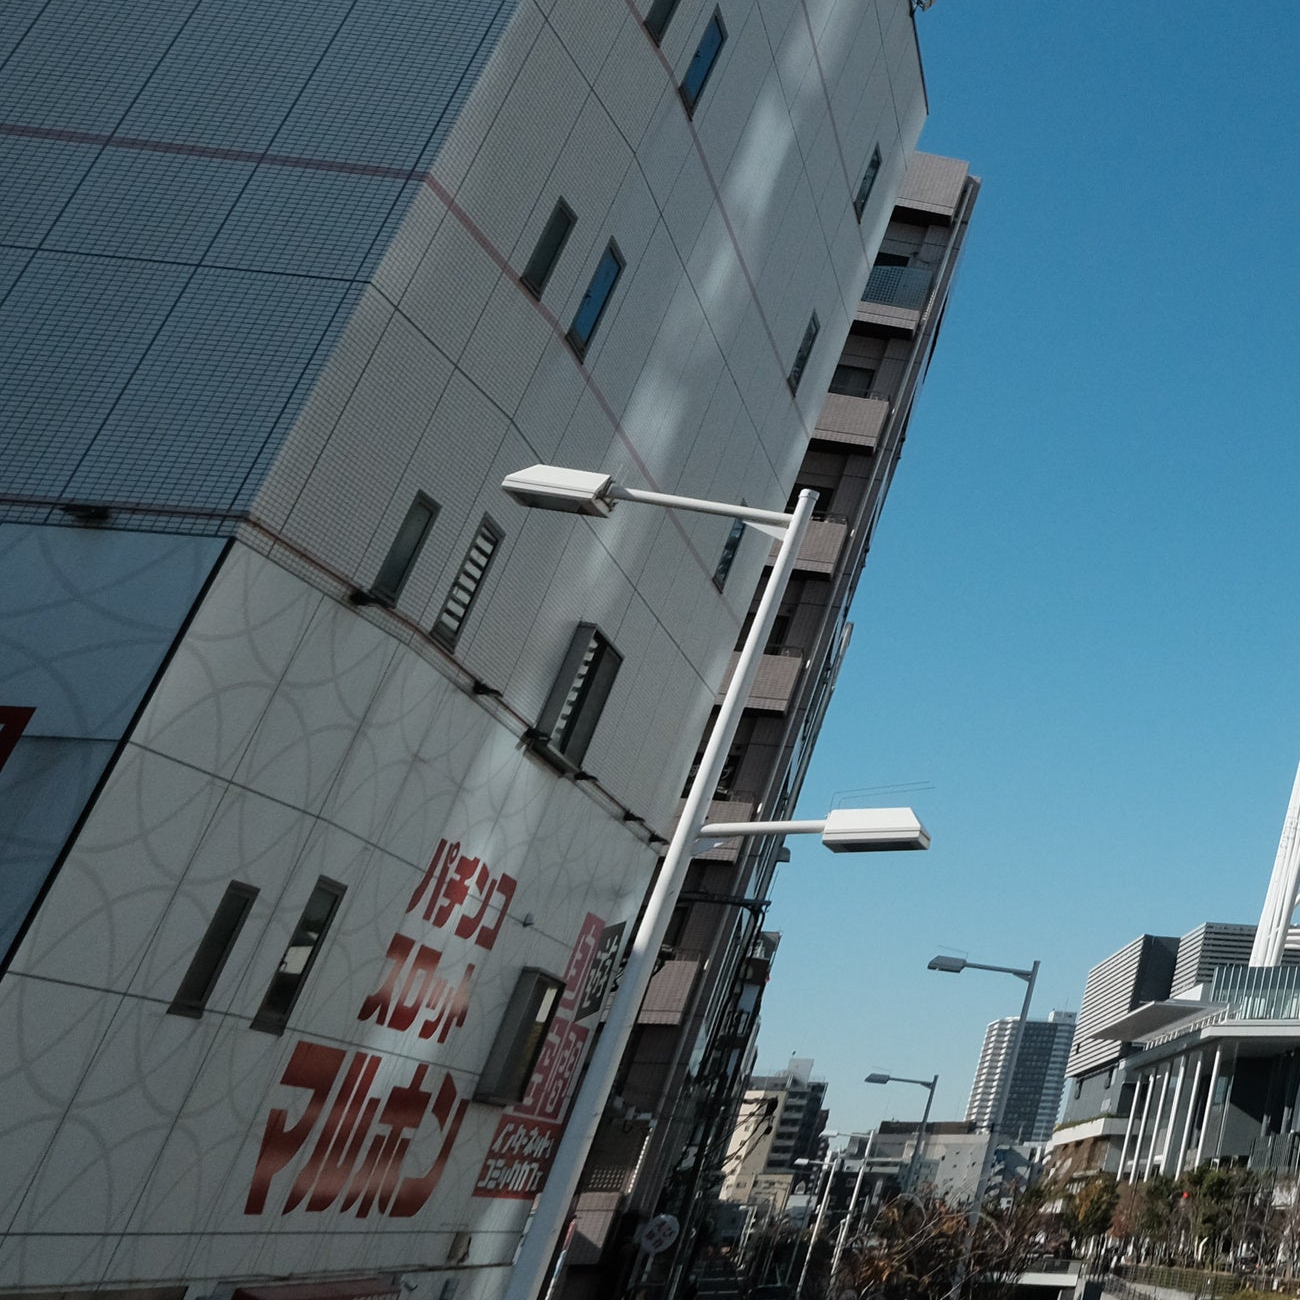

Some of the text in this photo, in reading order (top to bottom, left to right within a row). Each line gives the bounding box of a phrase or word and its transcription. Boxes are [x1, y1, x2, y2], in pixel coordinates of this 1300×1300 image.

[406, 838, 517, 950] パチンコ
[358, 933, 475, 1044] スロット
[244, 1040, 470, 1218] マルホン
